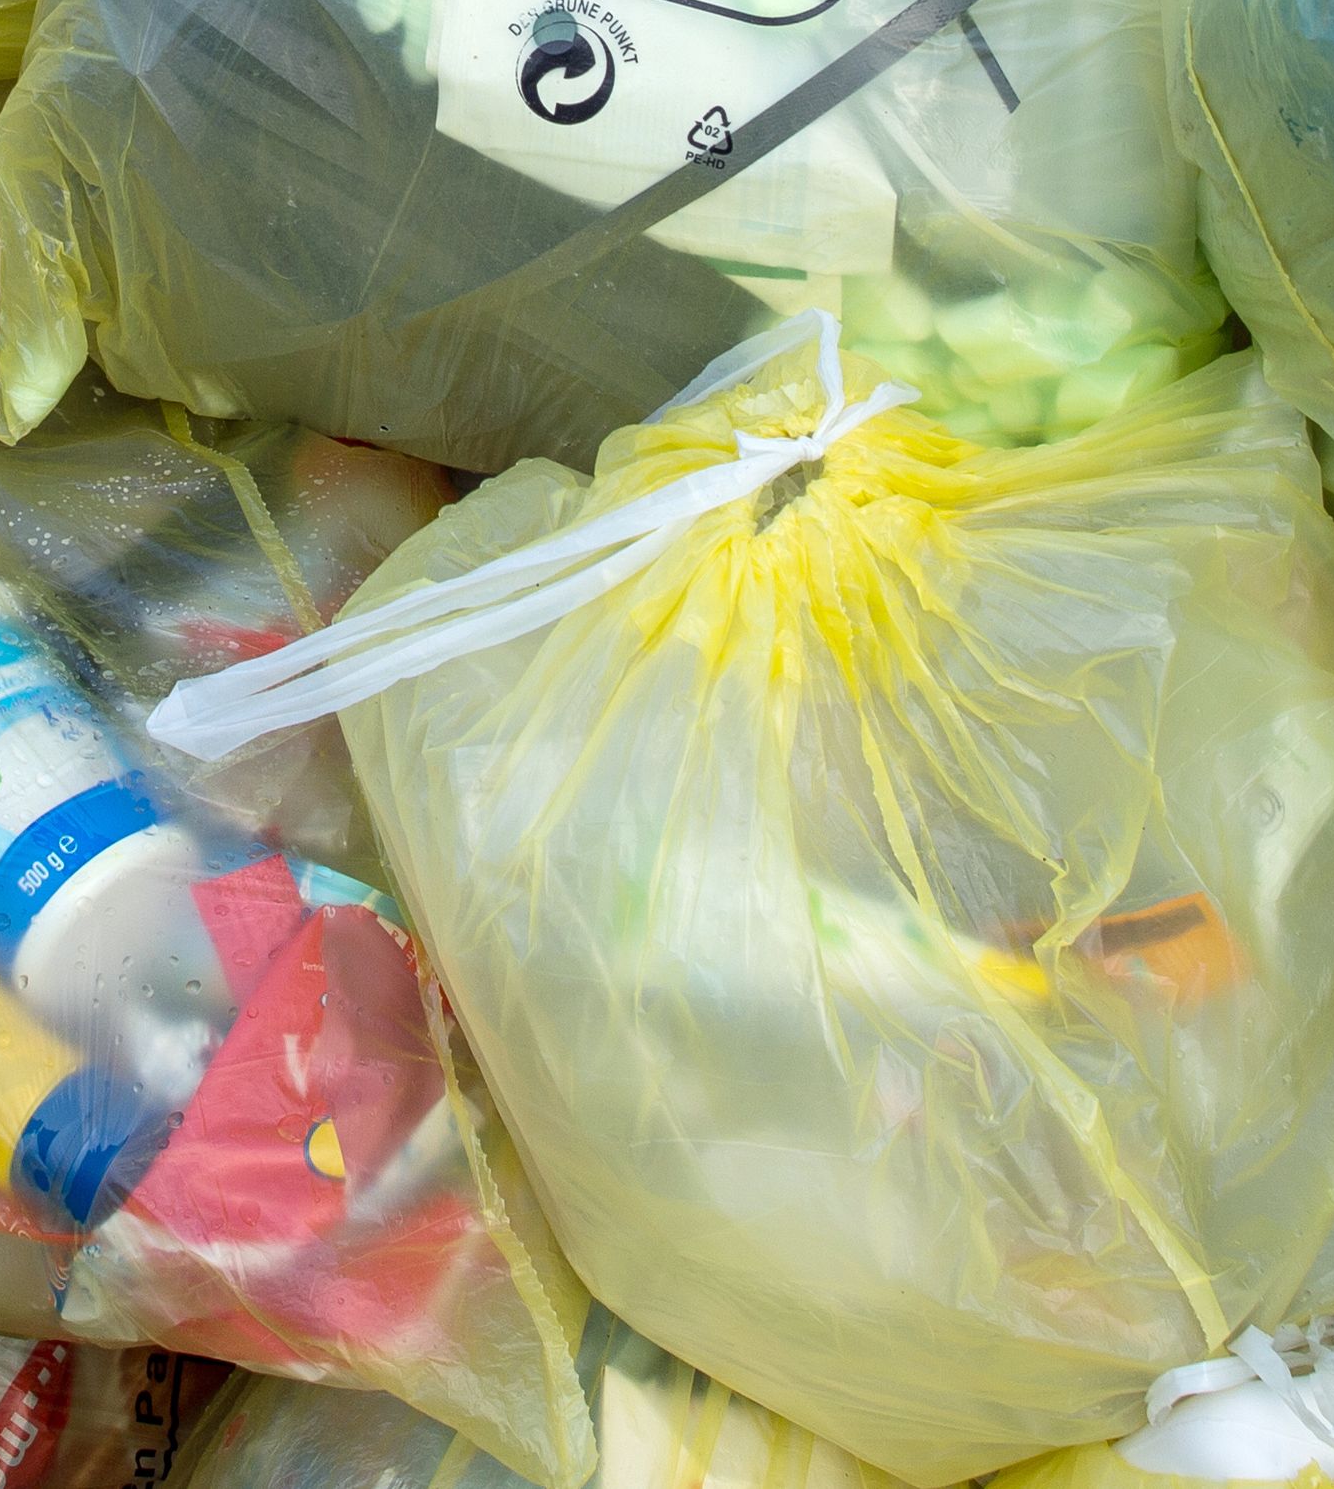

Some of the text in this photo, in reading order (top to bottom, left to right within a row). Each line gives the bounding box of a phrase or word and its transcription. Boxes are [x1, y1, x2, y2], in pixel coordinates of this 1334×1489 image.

[599, 11, 640, 66] PUNKT
[703, 123, 721, 139] 02
[684, 150, 726, 171] PE-HD
[17, 861, 50, 897] 500
[46, 851, 66, 873] g
